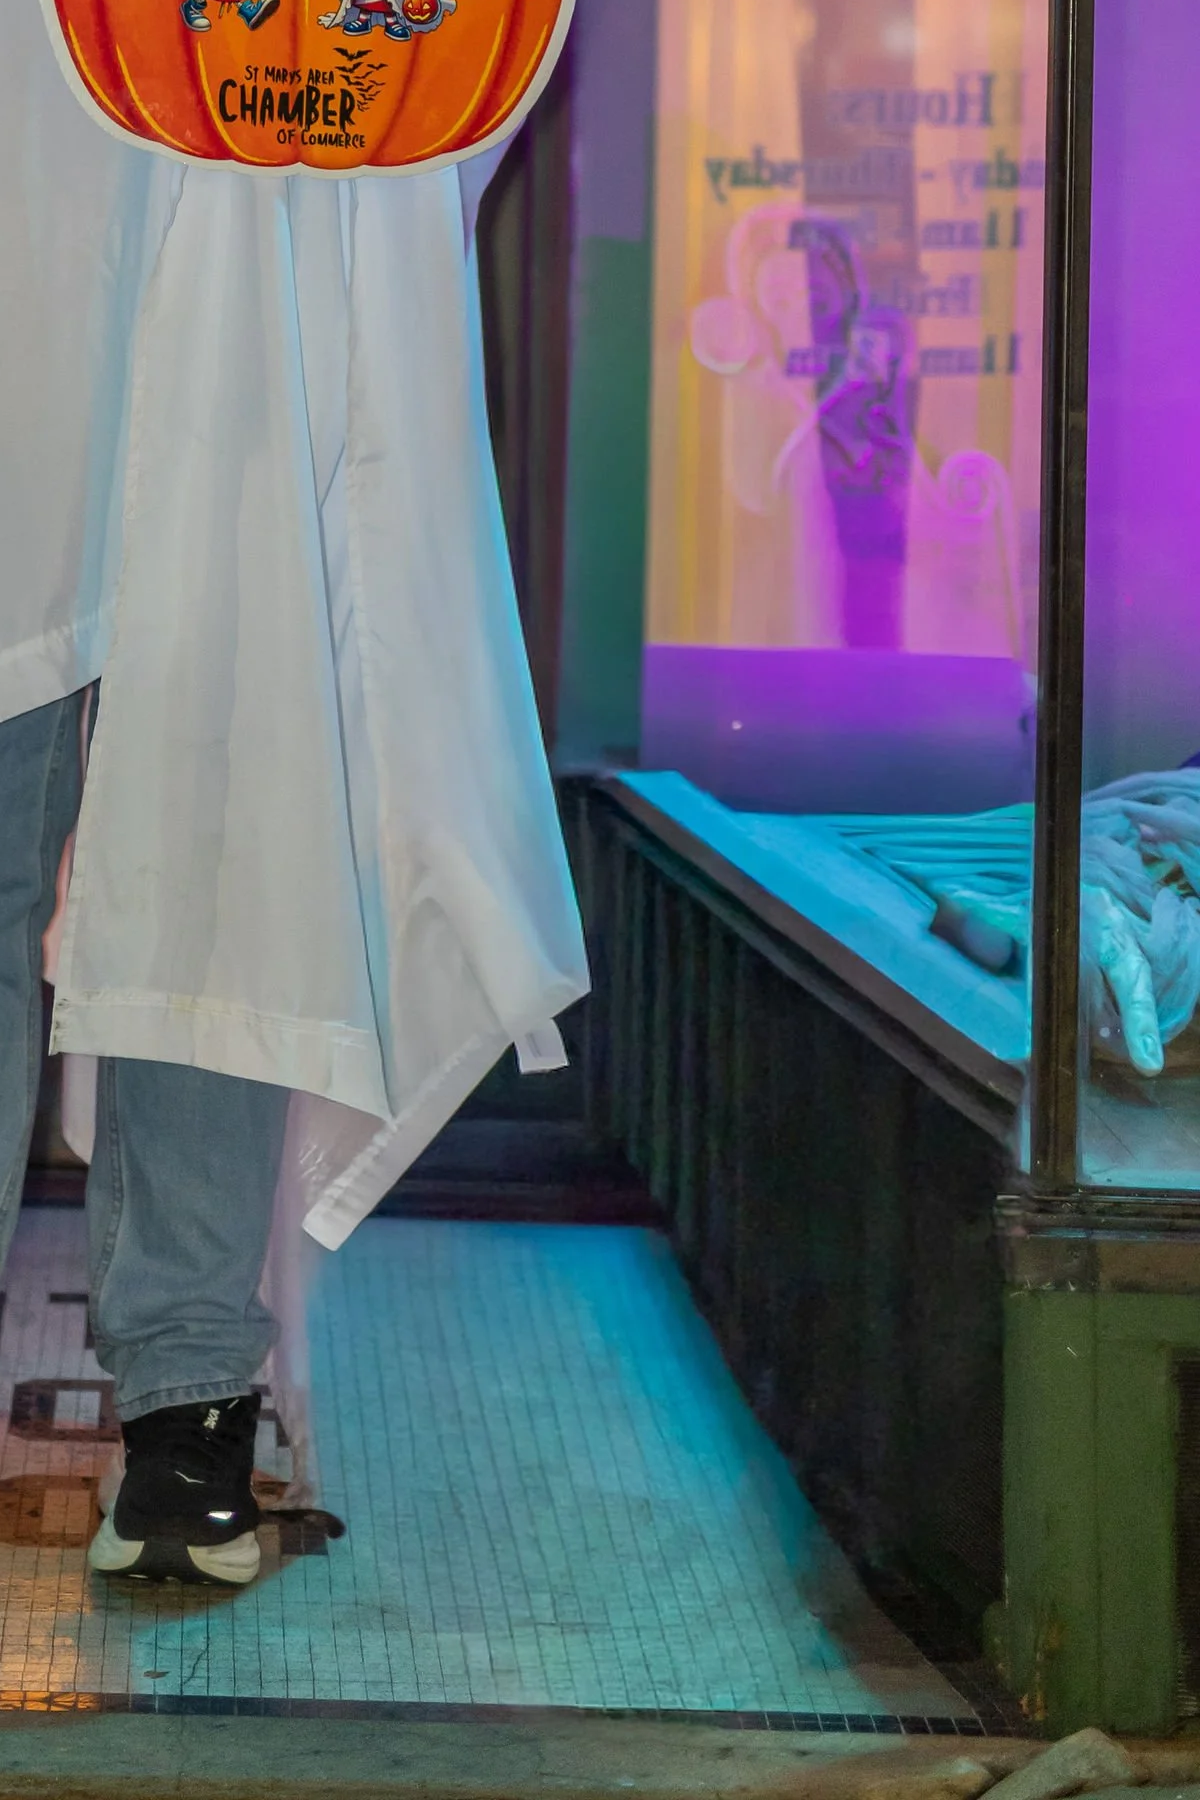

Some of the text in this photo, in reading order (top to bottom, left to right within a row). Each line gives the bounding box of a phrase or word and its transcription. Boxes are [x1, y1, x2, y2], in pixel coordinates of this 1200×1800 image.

[306, 68, 335, 86] AREA
[218, 78, 356, 132] CHAMBER
[276, 128, 366, 149] OF COMMERCE
